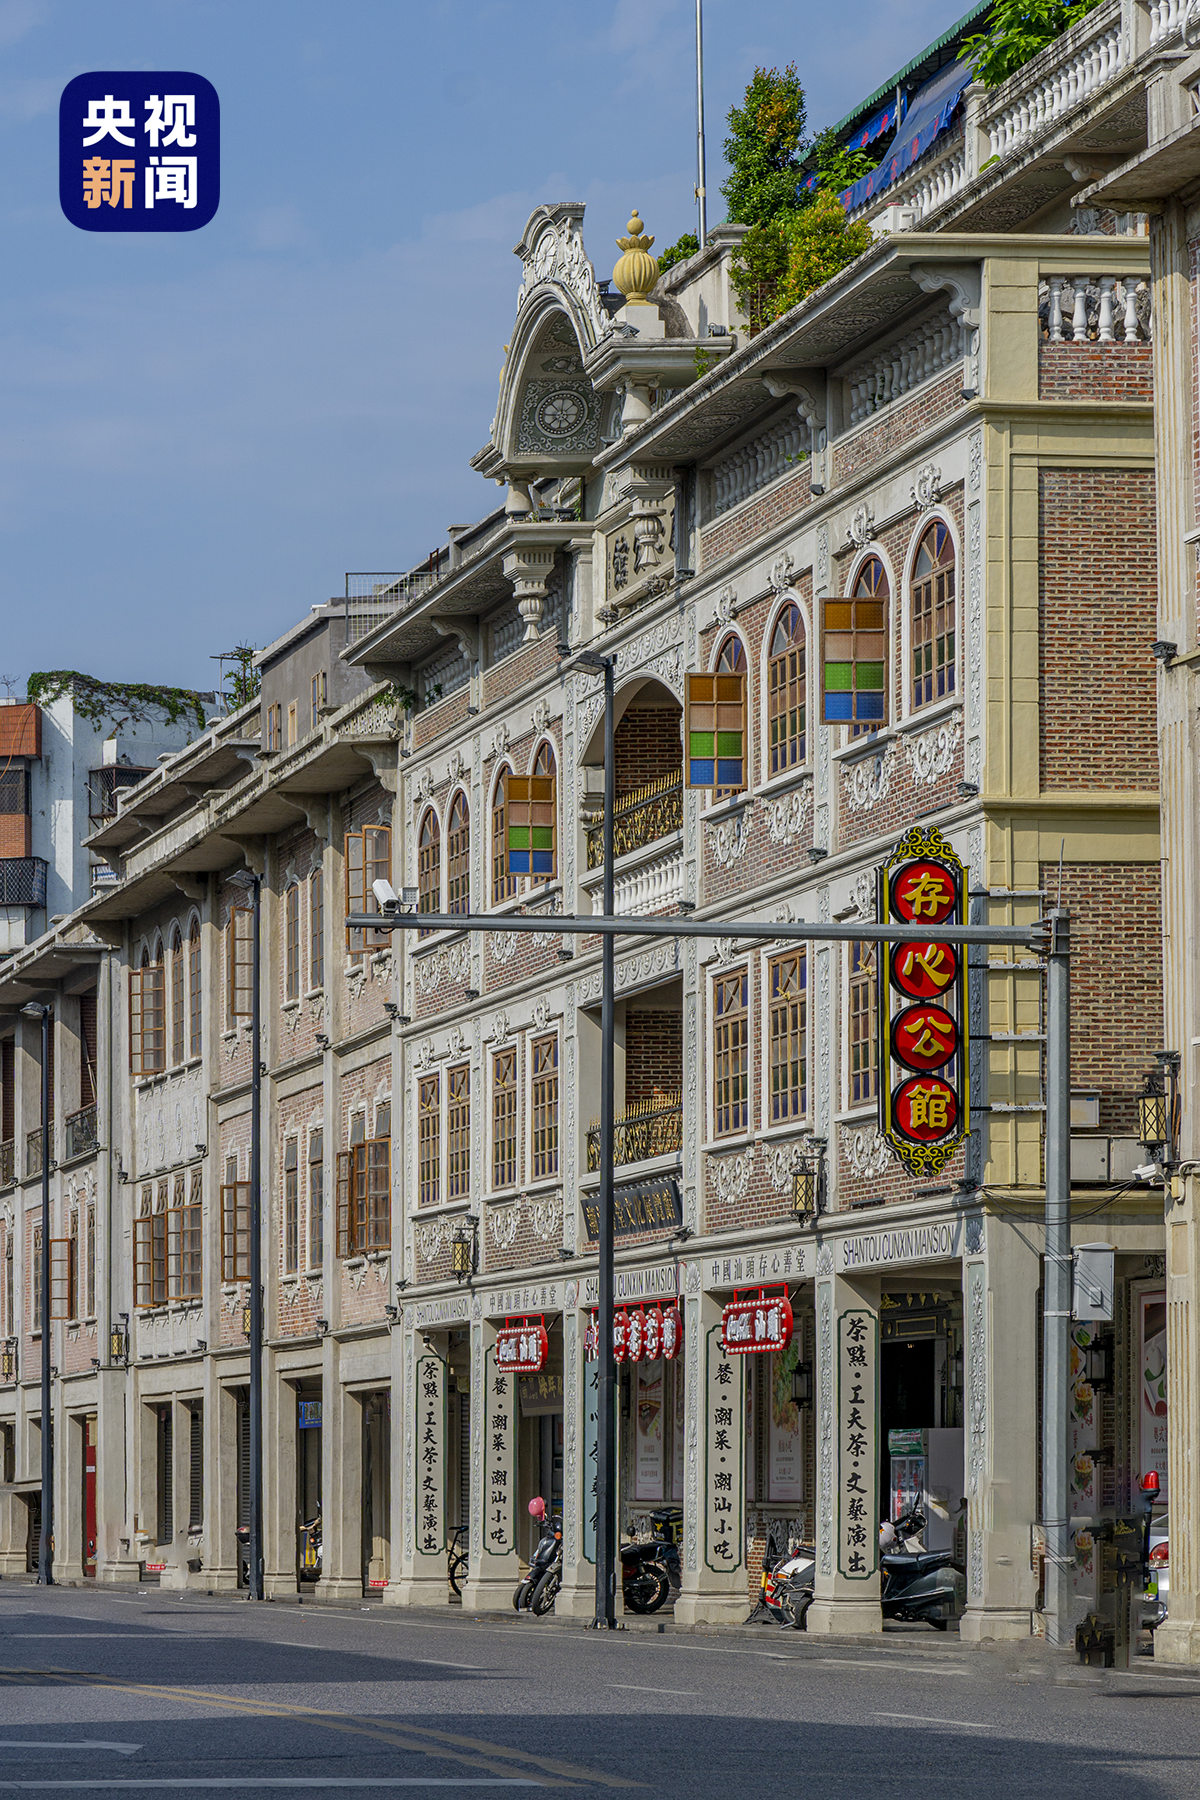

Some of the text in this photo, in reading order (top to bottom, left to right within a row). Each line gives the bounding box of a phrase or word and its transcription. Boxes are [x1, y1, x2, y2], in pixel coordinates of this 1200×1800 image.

[902, 872, 951, 1130] 存心公館
[843, 1236, 881, 1266] SHANTOU
[914, 1225, 954, 1256] MANSION
[712, 1249, 806, 1284] 中國汕頭存心善堂
